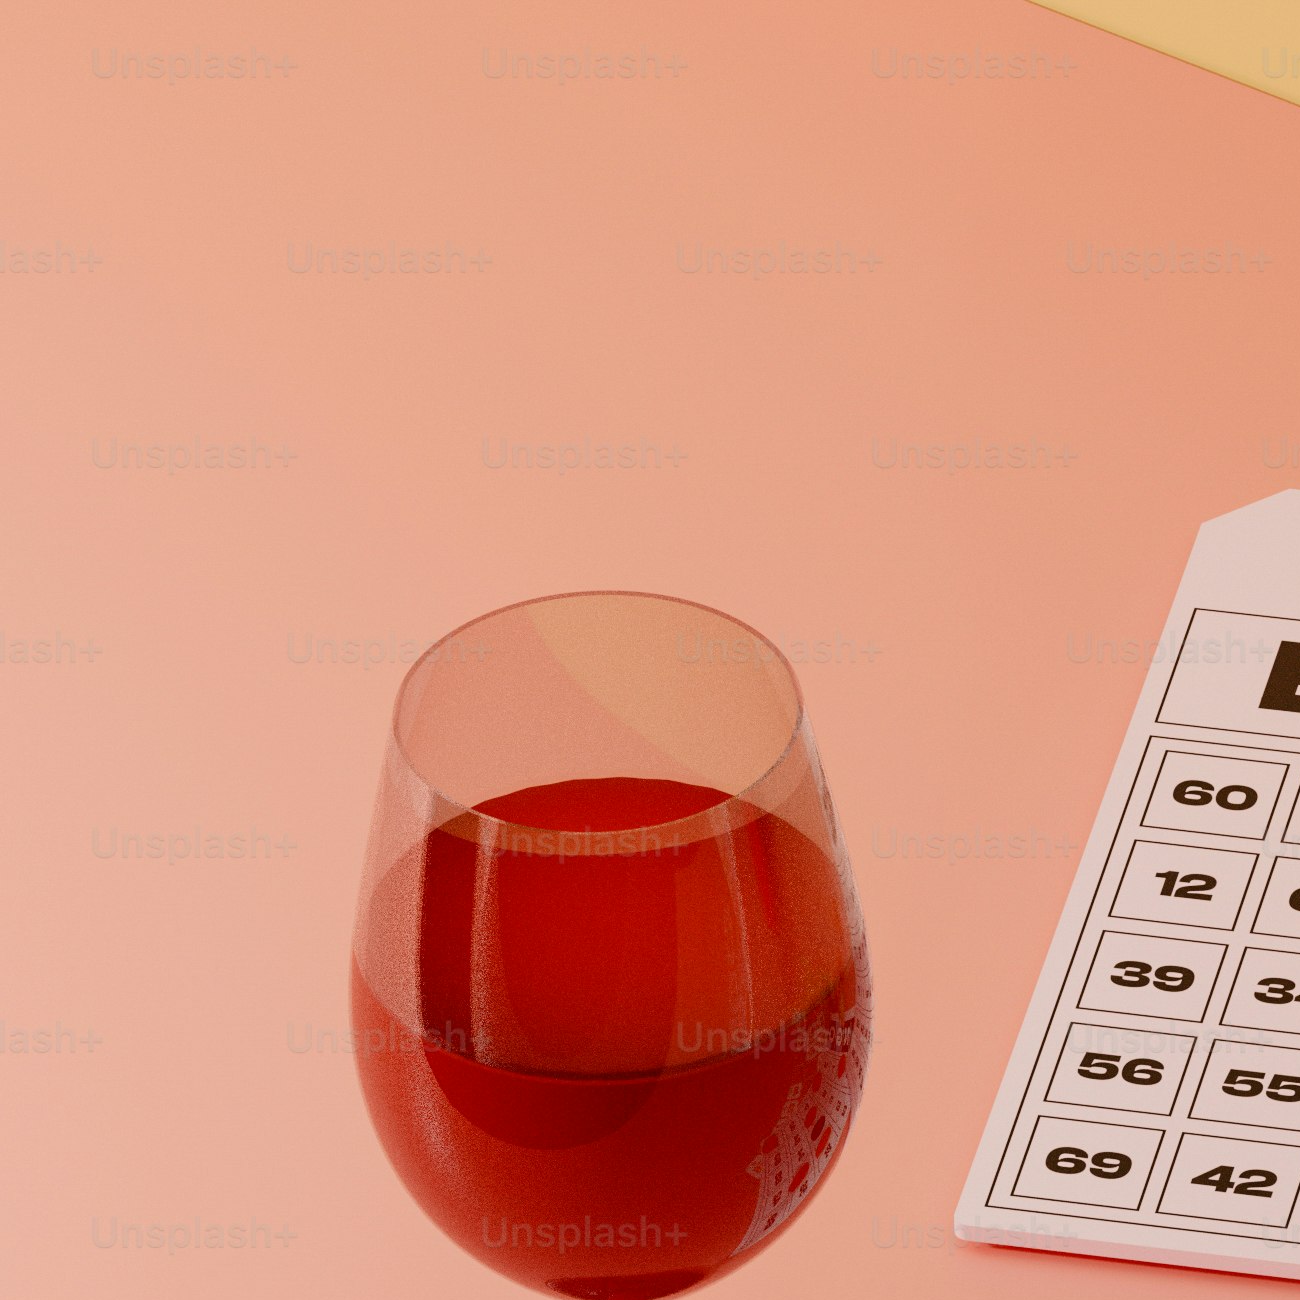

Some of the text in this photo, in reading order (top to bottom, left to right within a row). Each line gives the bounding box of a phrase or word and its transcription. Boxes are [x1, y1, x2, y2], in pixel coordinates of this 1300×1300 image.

[1172, 779, 1258, 811] 60
[1155, 870, 1217, 902] 12
[1110, 960, 1195, 993] 39
[1077, 1051, 1165, 1086] 56
[1045, 1146, 1133, 1180] 69
[1190, 1165, 1278, 1199] 42
